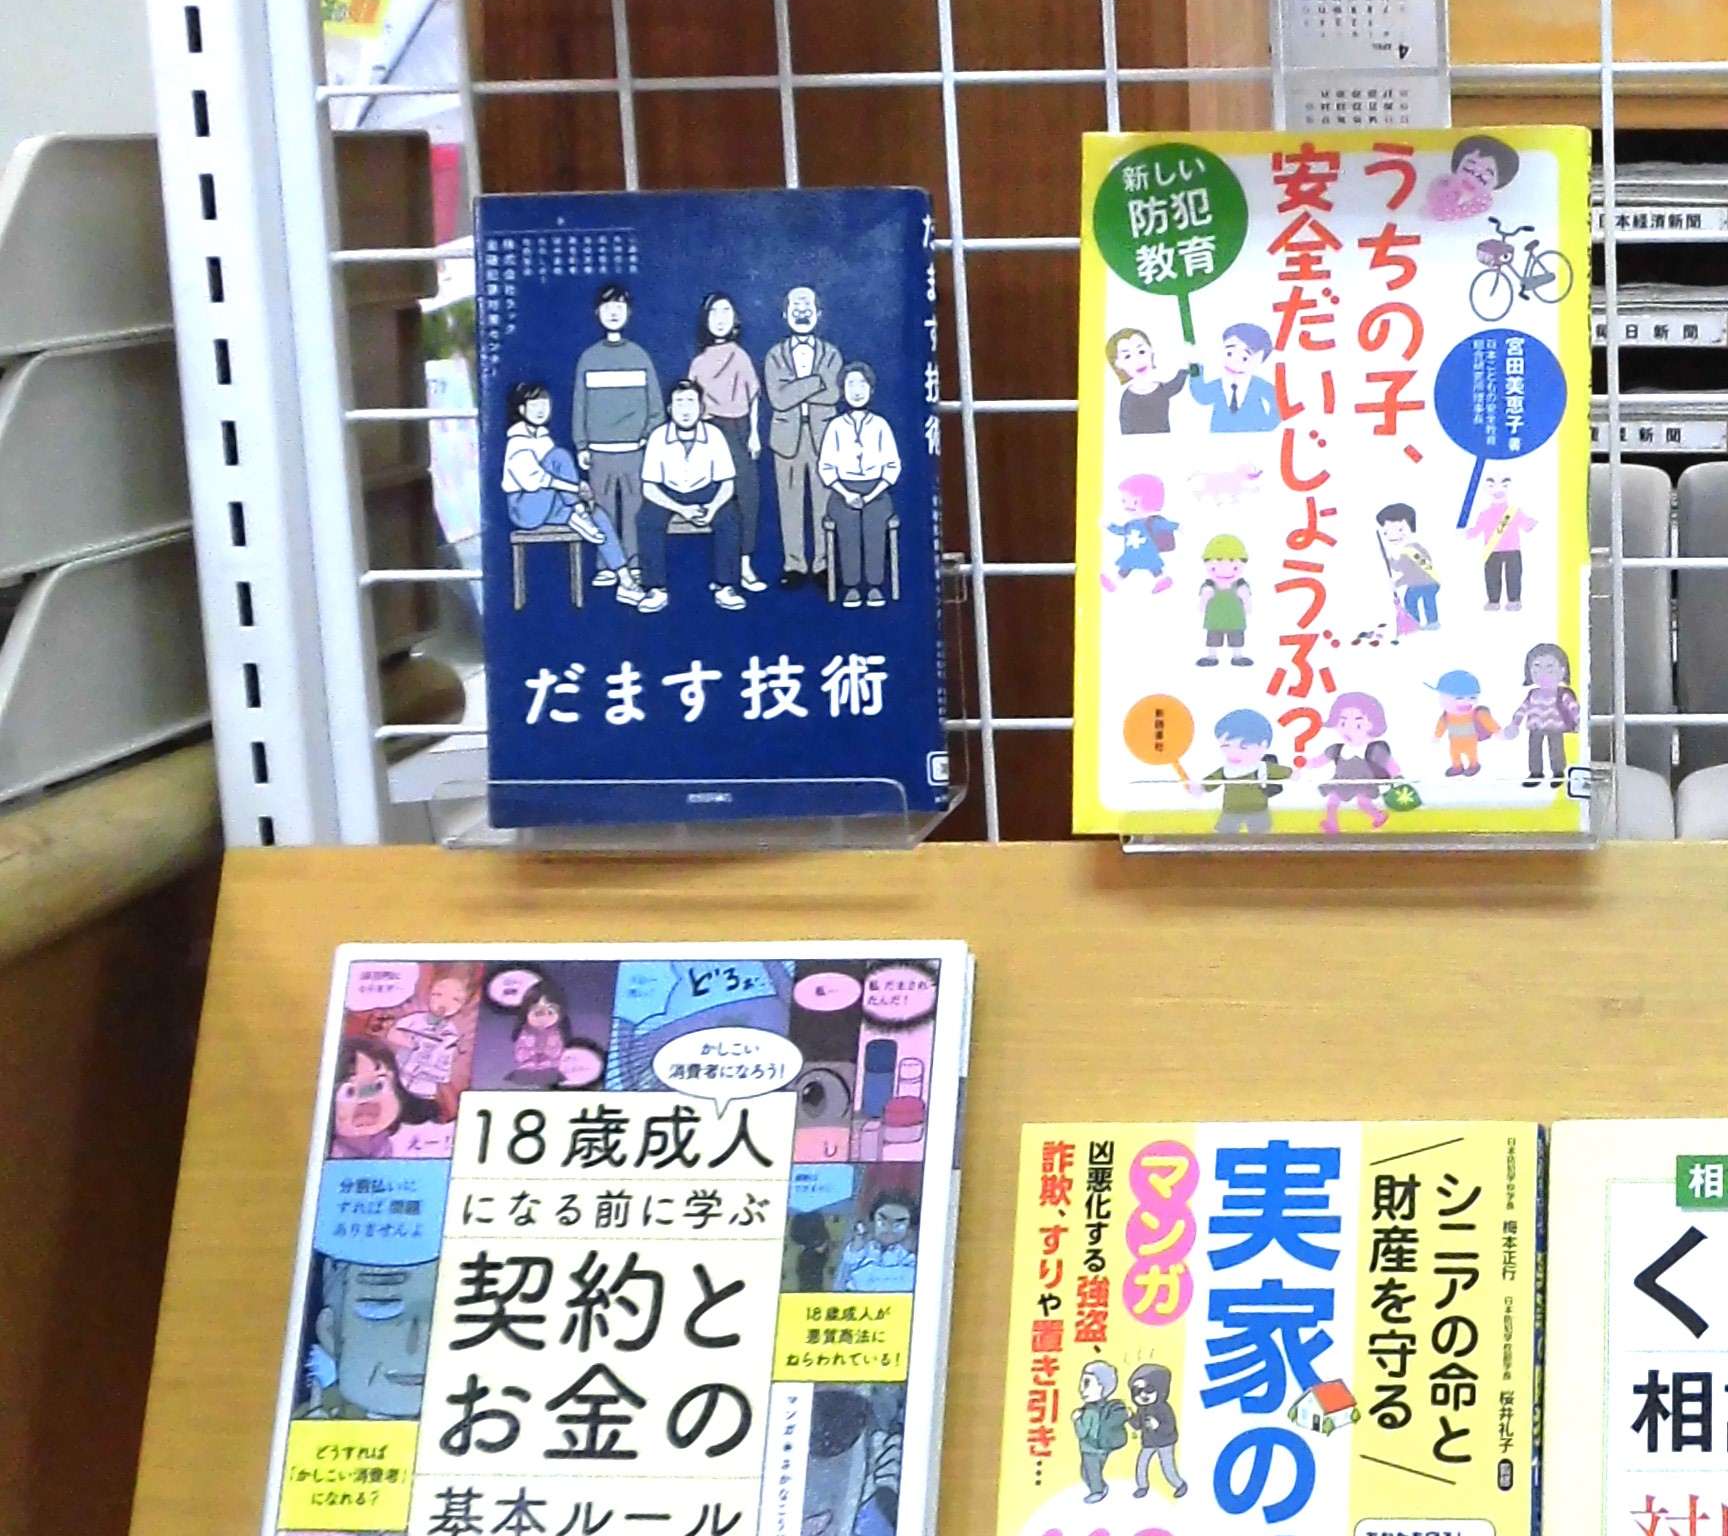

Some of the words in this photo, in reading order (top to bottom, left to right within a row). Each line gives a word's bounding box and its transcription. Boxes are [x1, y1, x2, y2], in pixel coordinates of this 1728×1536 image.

[1122, 157, 1206, 192] 新しい
[1128, 188, 1212, 238] 防犯
[1135, 235, 1216, 285] 教育
[1354, 141, 1427, 465] うちの子、
[1266, 141, 1344, 770] 安全だいじょうぶ?
[525, 655, 888, 725] だます技術
[669, 1063, 786, 1081] 消費者になろう!
[700, 1042, 760, 1057] かしこい
[472, 1103, 775, 1171] 18歳成人
[333, 1222, 423, 1238] ありませんよ
[462, 1189, 770, 1231] になる前に学ぶ
[1132, 1154, 1190, 1315] マンガ
[1074, 1140, 1115, 1356] 凶悪化する強盗、
[1501, 1220, 1518, 1282] 梅本正行
[448, 1248, 747, 1355] 契約と
[806, 1306, 891, 1321] 18歳成人が
[1368, 1174, 1418, 1431] 財産を守る
[1430, 1173, 1482, 1465] シニアの命と
[786, 1352, 901, 1367] ねらわれている!
[806, 1328, 885, 1344] 悪質商法に
[438, 1362, 754, 1461] お金の
[1497, 1390, 1515, 1454] 桜井礼子
[316, 1444, 387, 1461] どうすれば
[311, 1490, 379, 1507] になれる?
